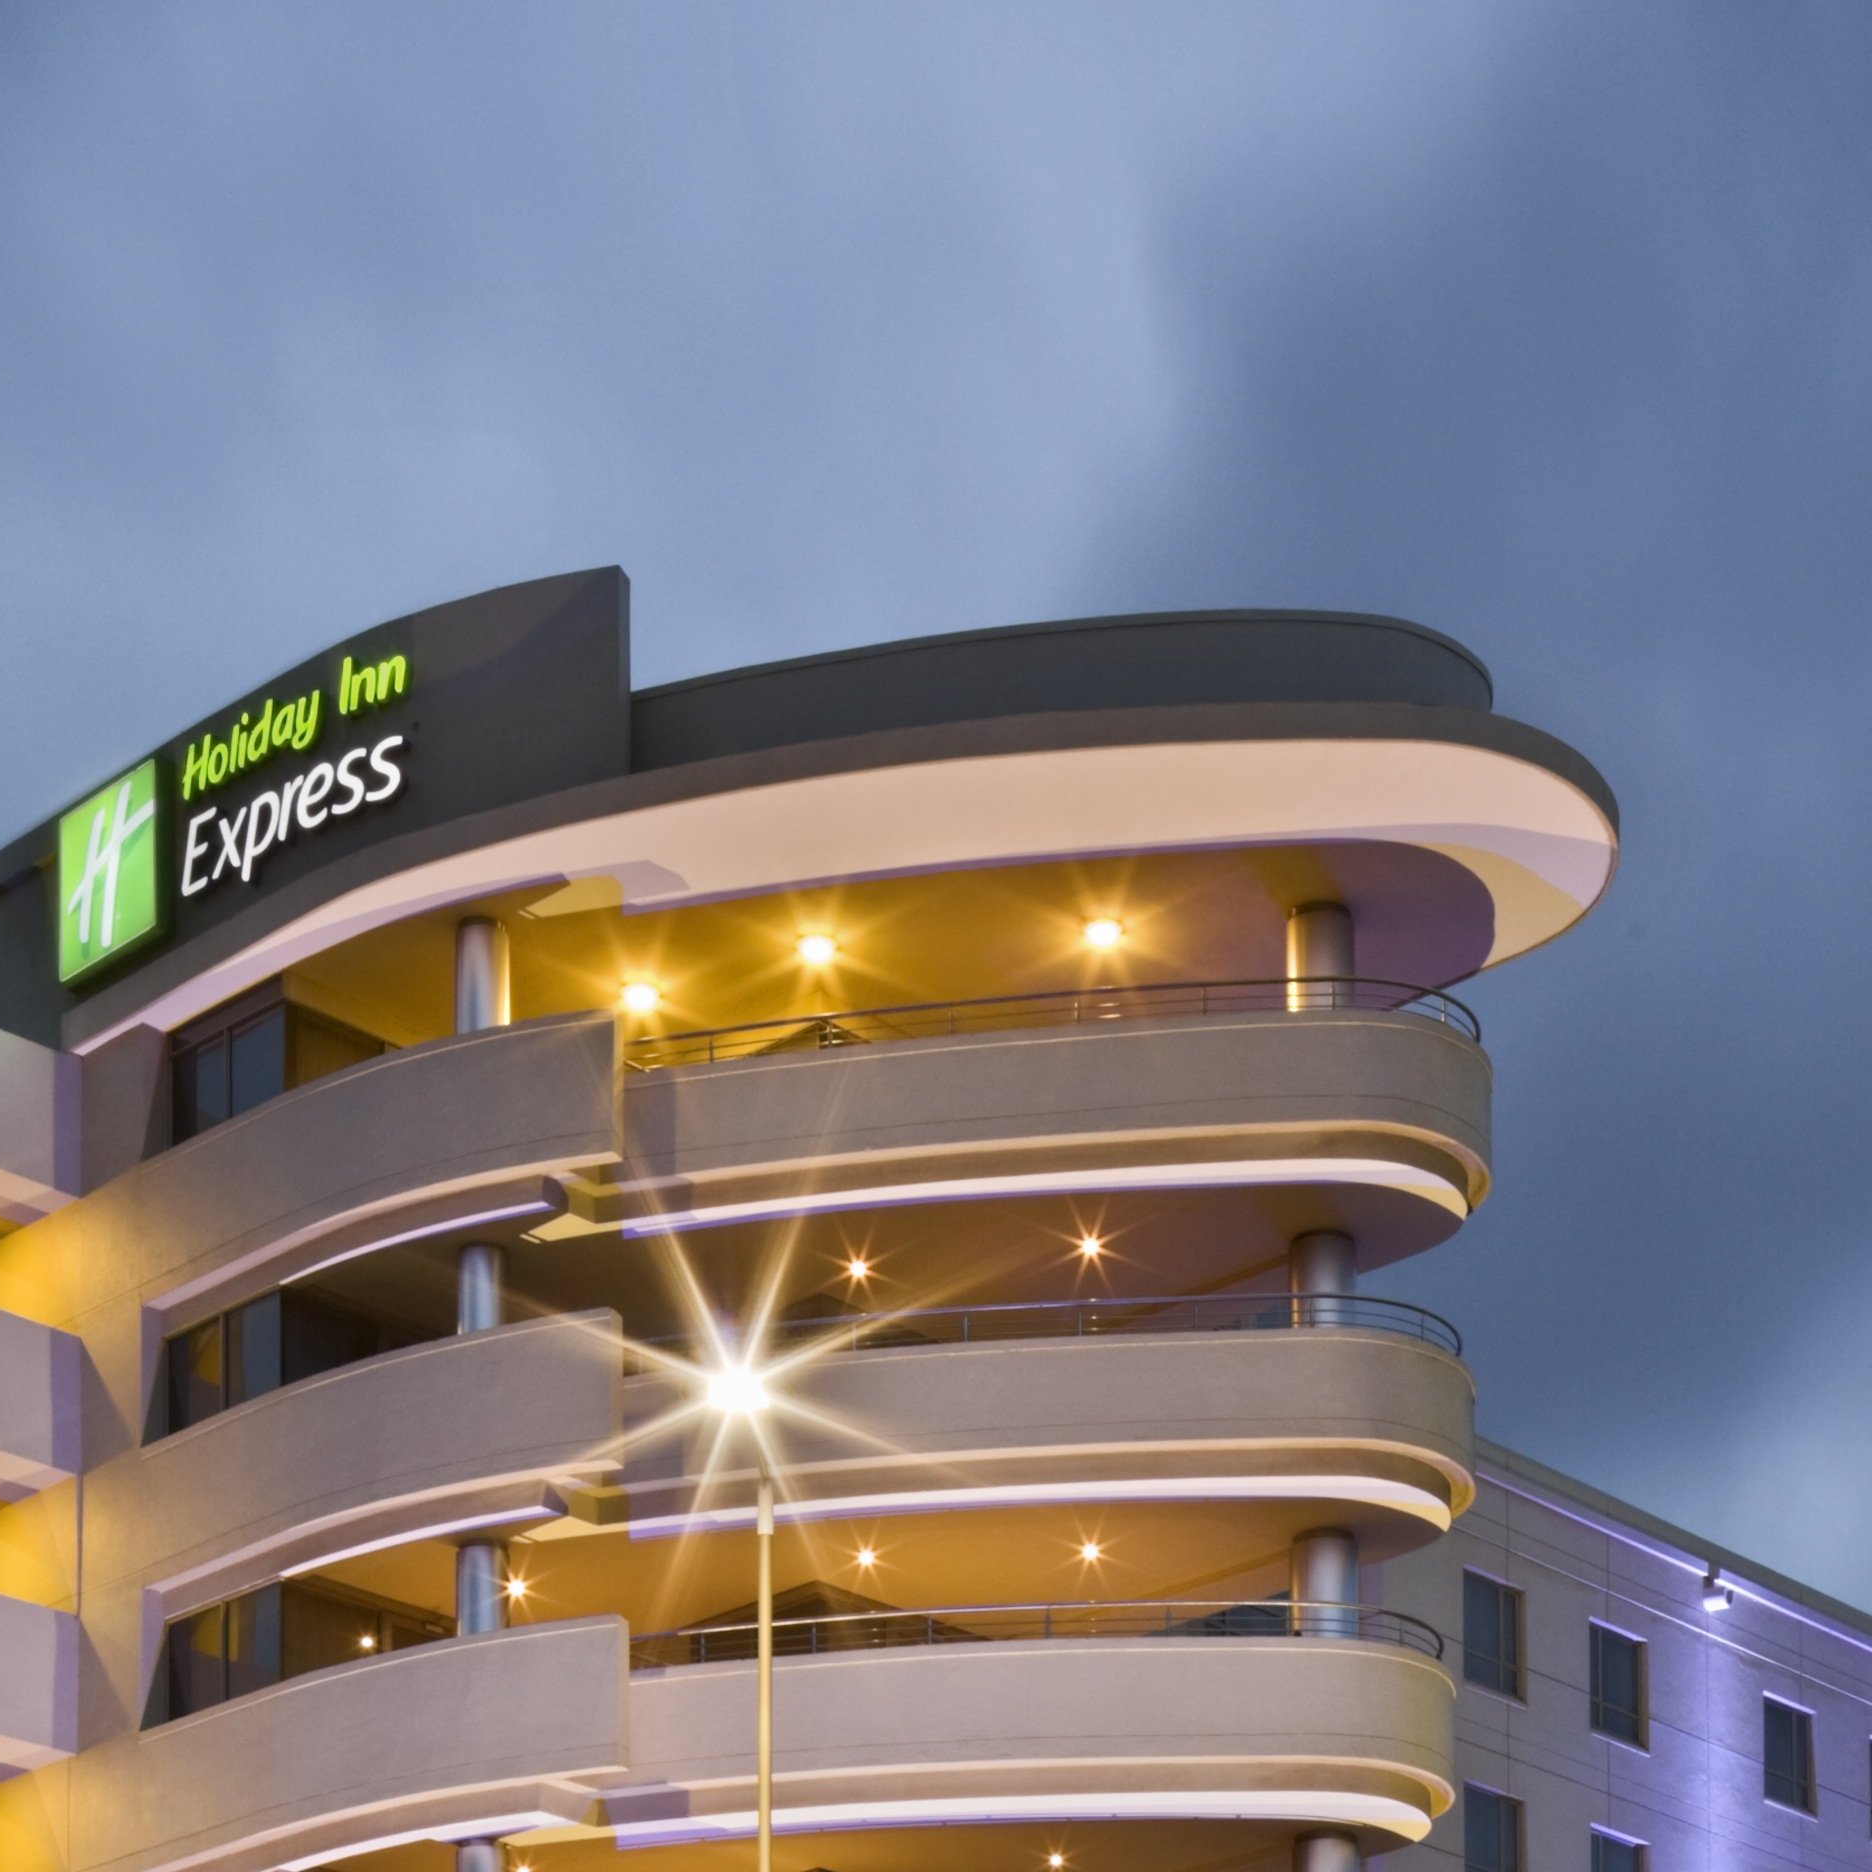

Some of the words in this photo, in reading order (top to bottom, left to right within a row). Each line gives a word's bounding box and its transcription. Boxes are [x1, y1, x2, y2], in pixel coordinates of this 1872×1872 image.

[181, 689, 320, 801] Holiday
[338, 654, 407, 715] Inn
[181, 734, 404, 897] Express
